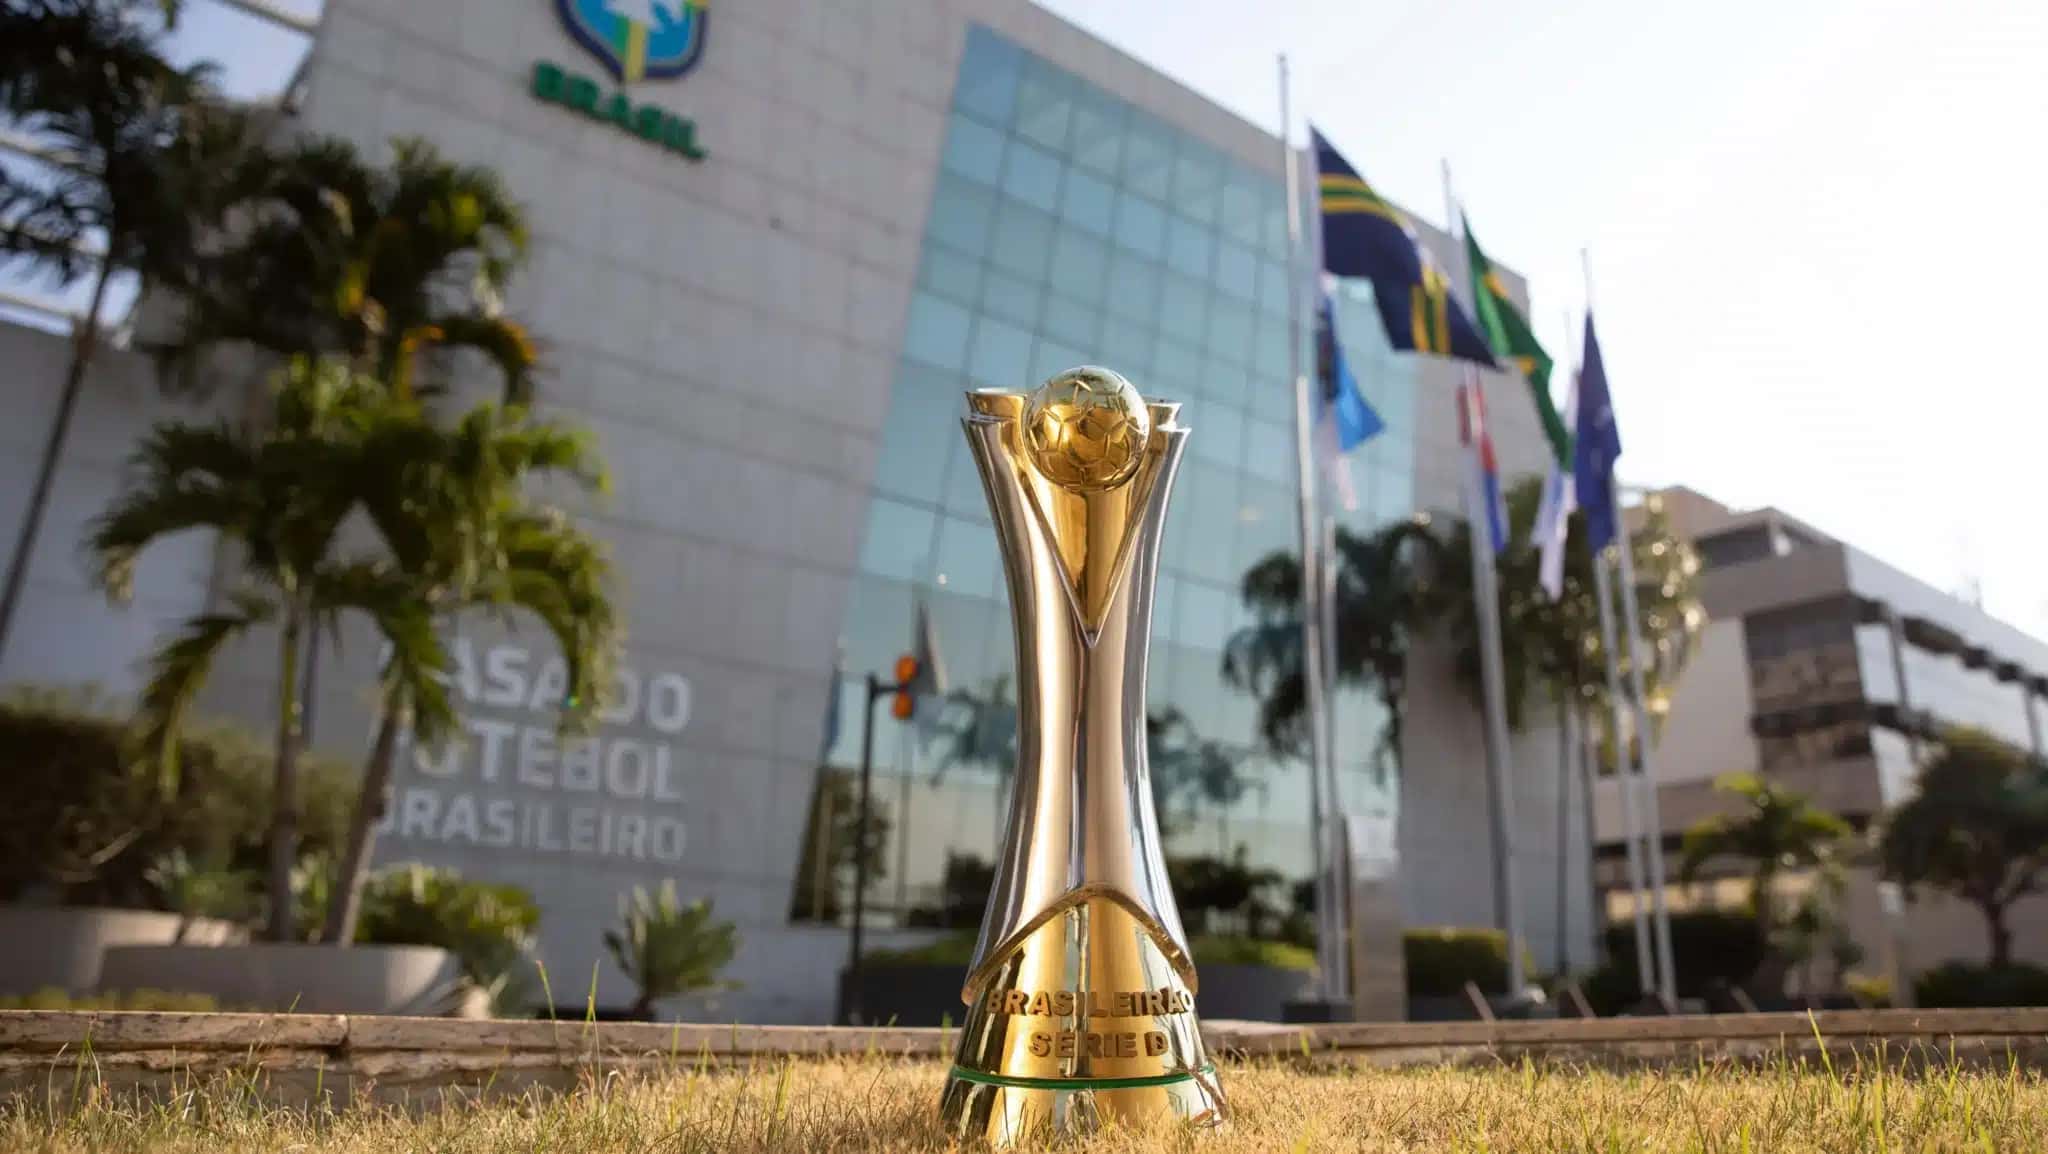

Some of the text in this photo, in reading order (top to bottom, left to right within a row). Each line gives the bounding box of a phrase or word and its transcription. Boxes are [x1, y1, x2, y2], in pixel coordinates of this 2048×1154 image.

[532, 62, 707, 160] BRASIL
[379, 638, 567, 711] ASA
[390, 718, 681, 801] UTEBOL
[1144, 1031, 1170, 1058] D
